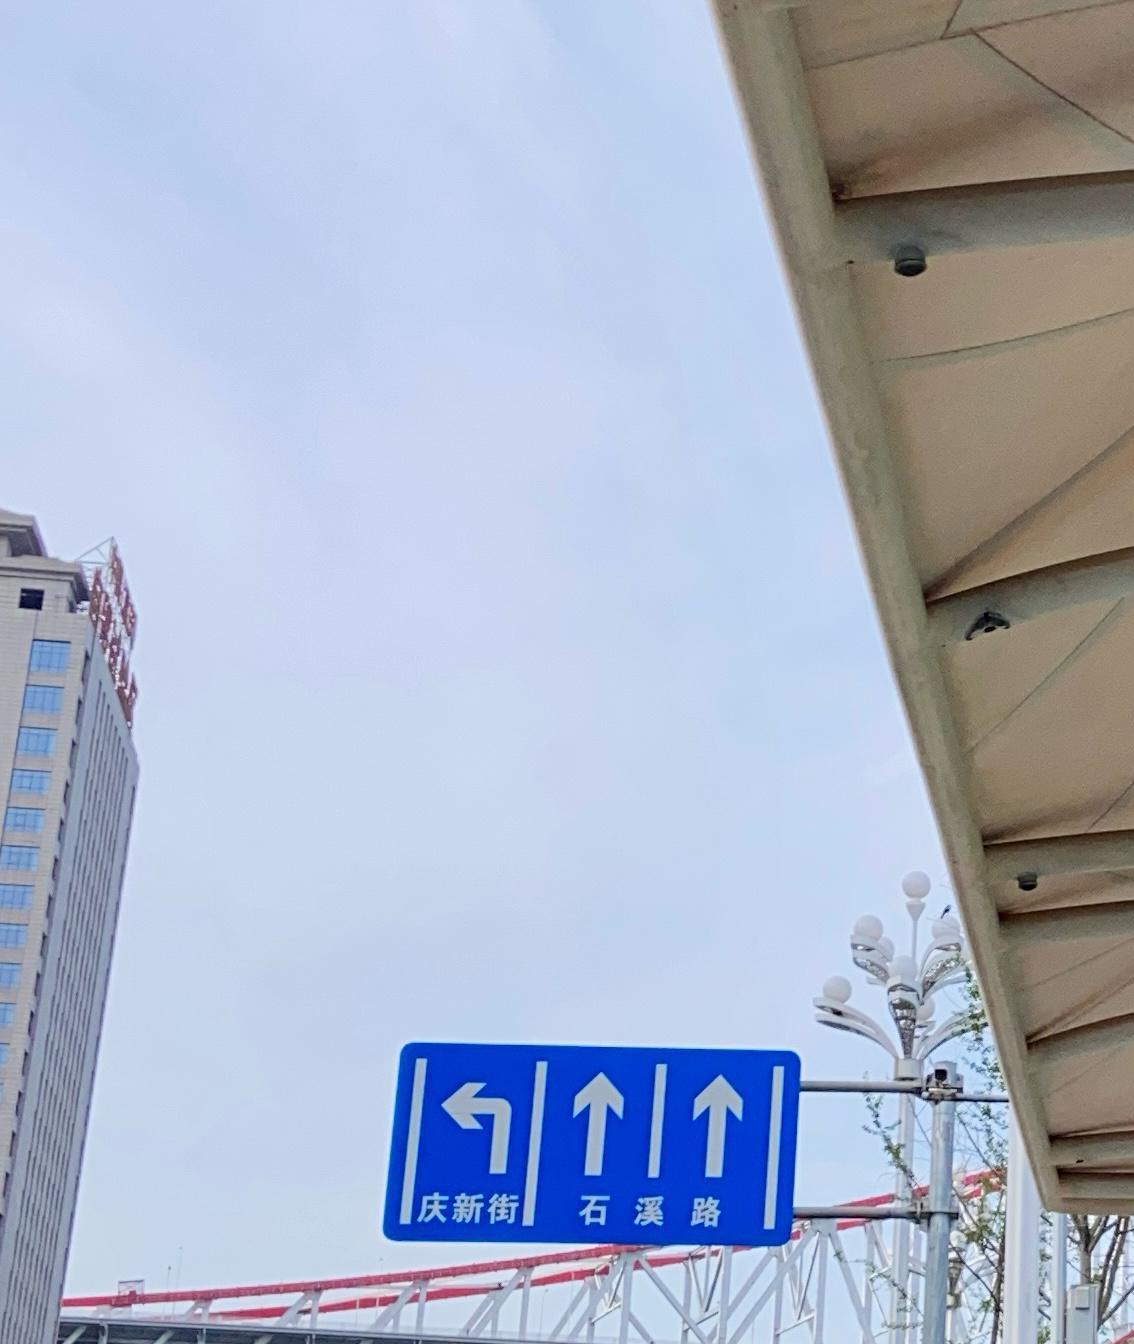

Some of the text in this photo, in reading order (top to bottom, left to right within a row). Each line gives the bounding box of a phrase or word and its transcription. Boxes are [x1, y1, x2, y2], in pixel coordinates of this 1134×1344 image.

[417, 1192, 519, 1224] 庆新街
[578, 1195, 721, 1227] 石溪路
